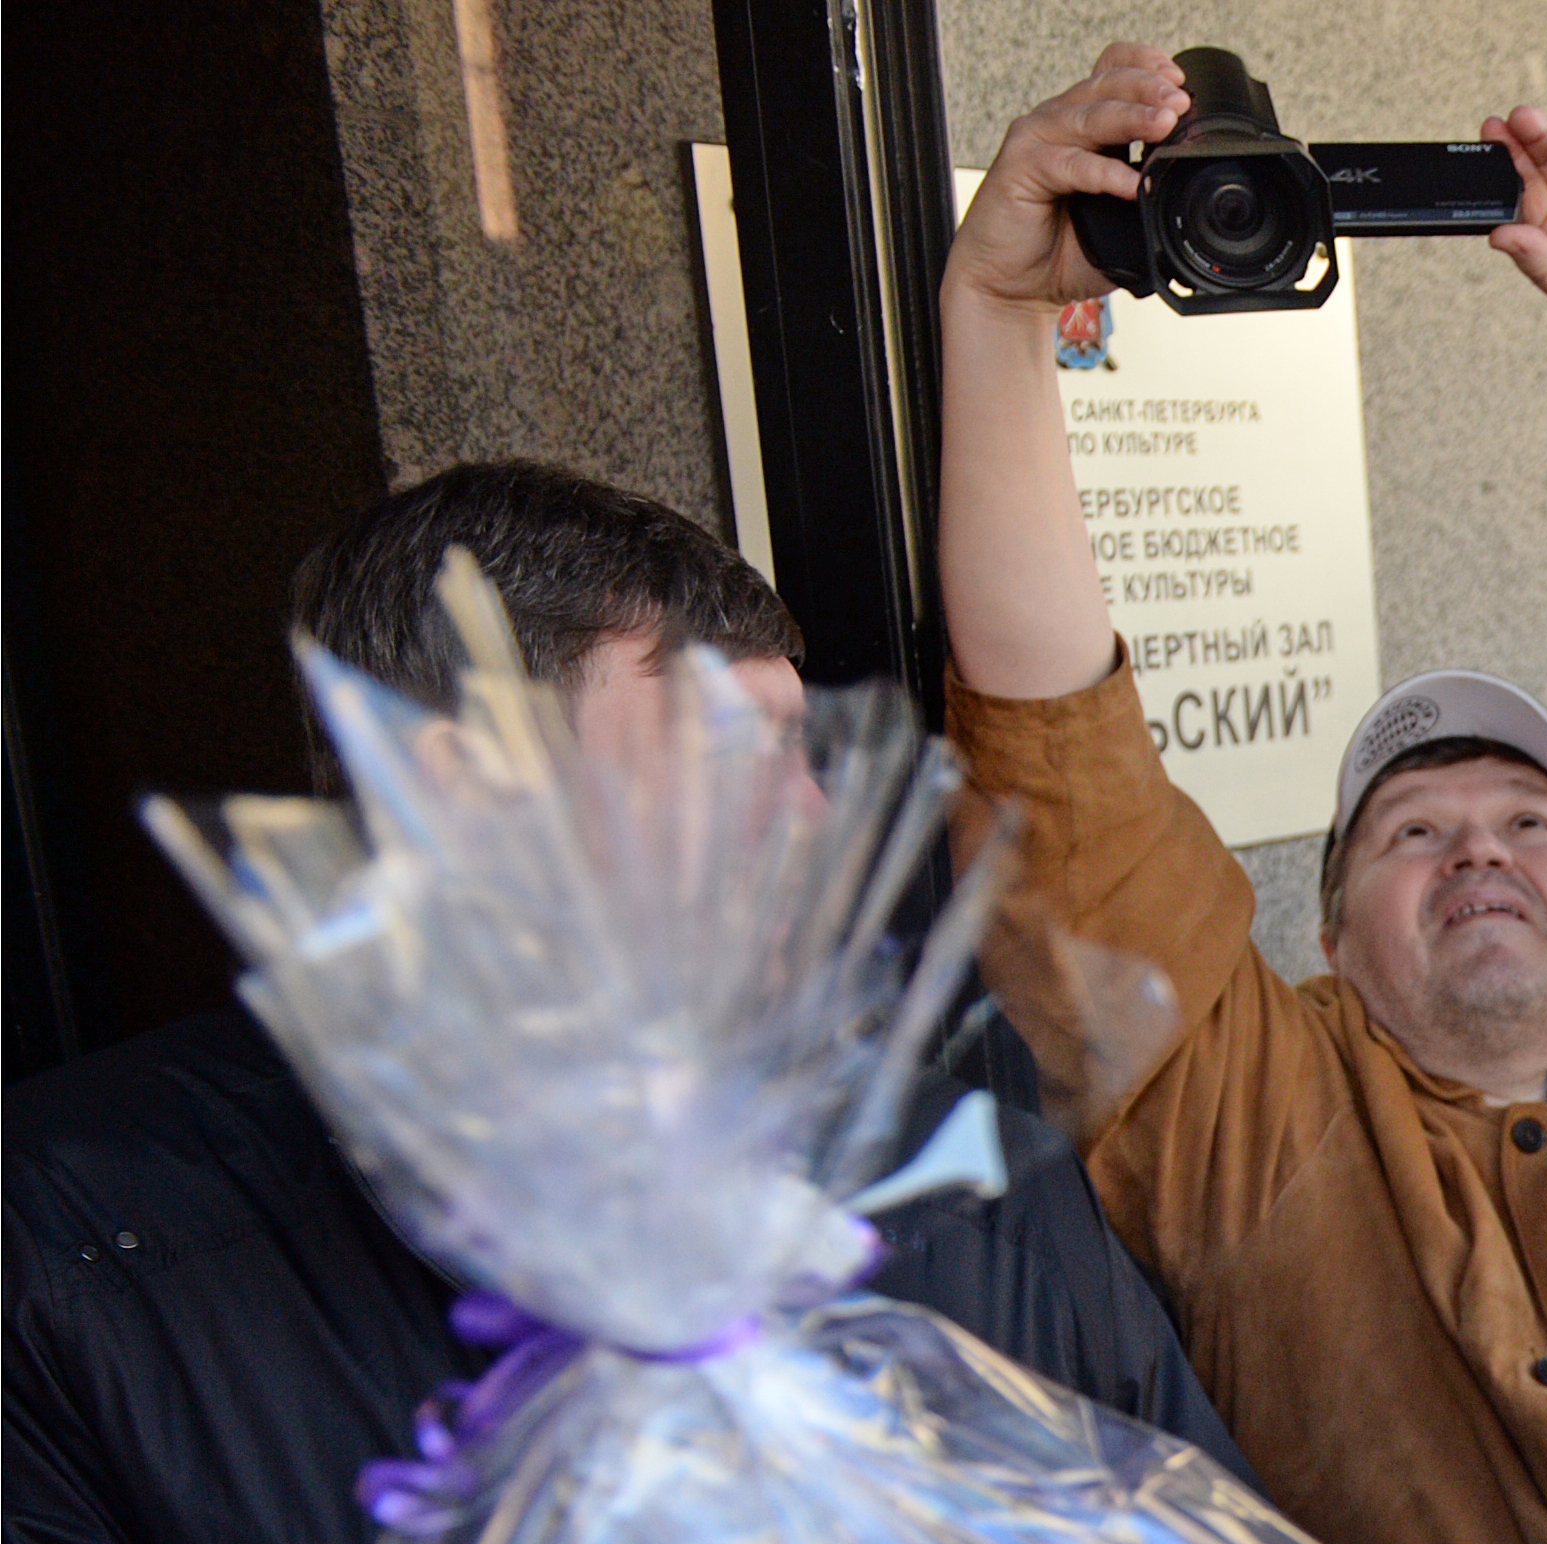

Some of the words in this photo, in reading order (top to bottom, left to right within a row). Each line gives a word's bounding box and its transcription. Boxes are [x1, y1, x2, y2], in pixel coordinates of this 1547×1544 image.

[1446, 143, 1494, 154] SONY
[1329, 166, 1382, 184] 4K
[1070, 398, 1262, 424] САНКТ-ПЕТЕРБУРГА
[1066, 430, 1097, 455] ПО
[1102, 430, 1199, 456] КУЛЬТУРЕ
[1143, 522, 1301, 565] БЮДЖЕТНОЕ
[1123, 567, 1254, 604] КУЛЬТУРЫ
[1278, 618, 1335, 659] ЗАЛ
